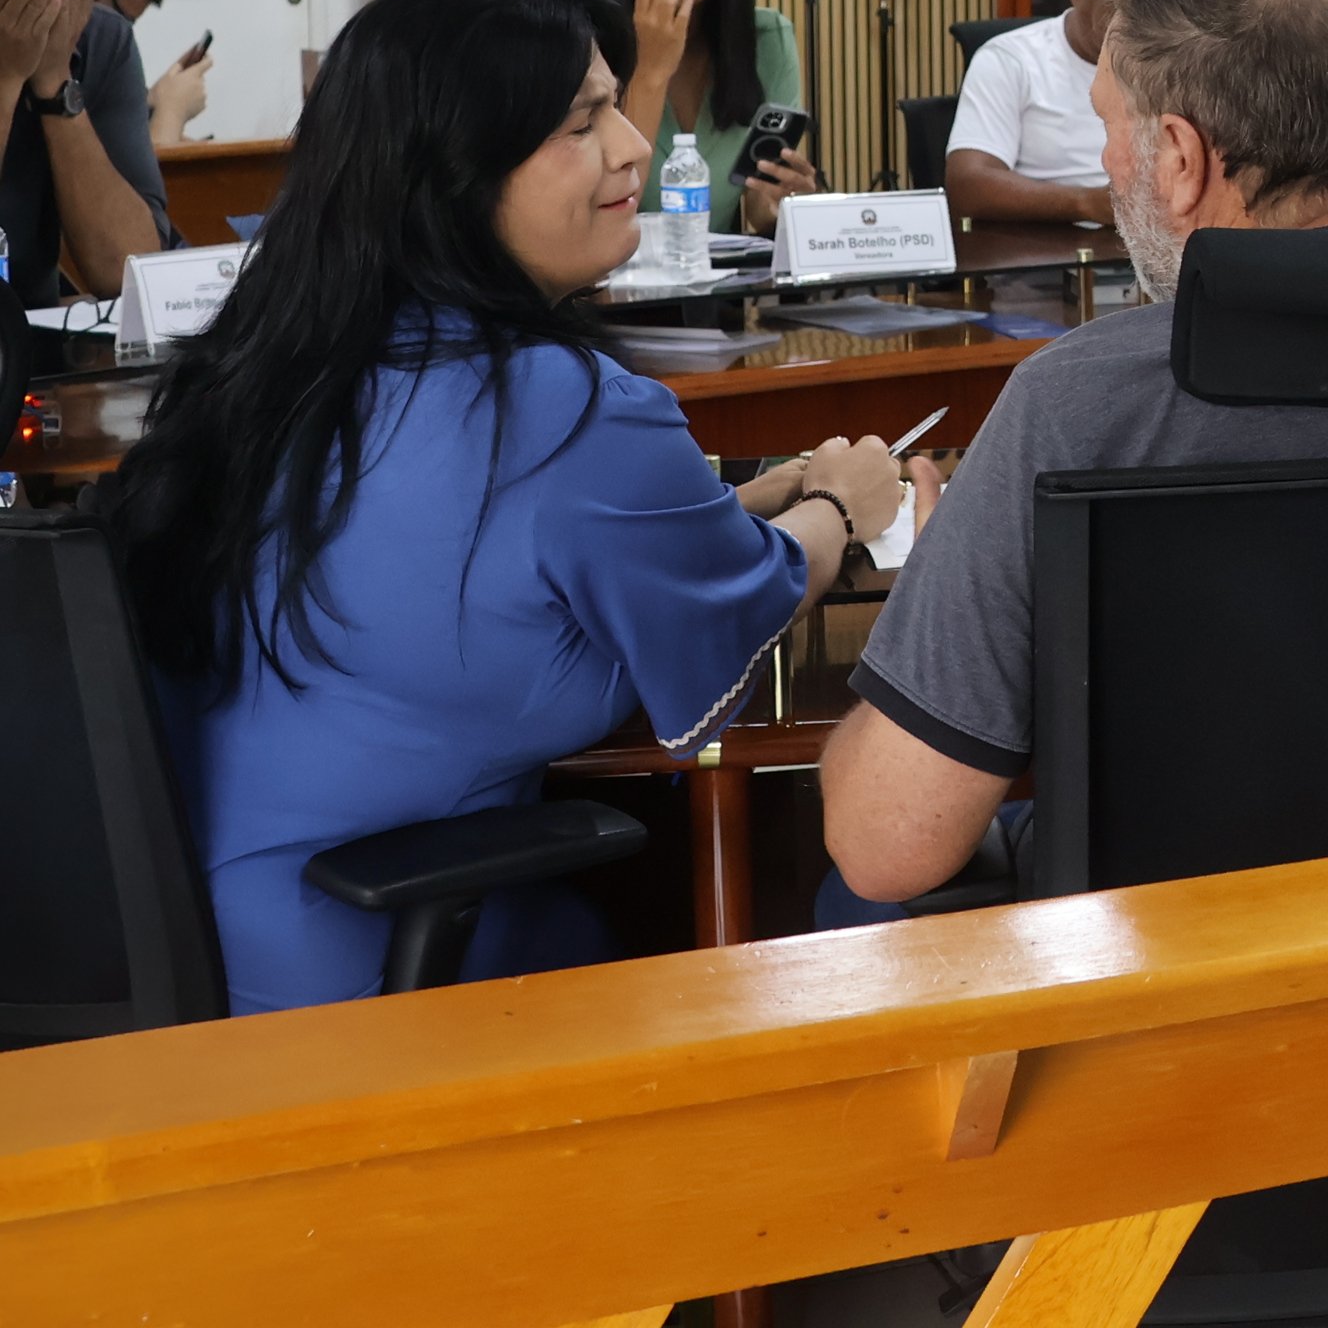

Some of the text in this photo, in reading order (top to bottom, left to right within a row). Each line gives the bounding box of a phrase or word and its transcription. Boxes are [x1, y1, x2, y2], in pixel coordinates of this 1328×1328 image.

[808, 234, 935, 250] Sarah Botelho (PSD)
[854, 251, 893, 260] Vereadora
